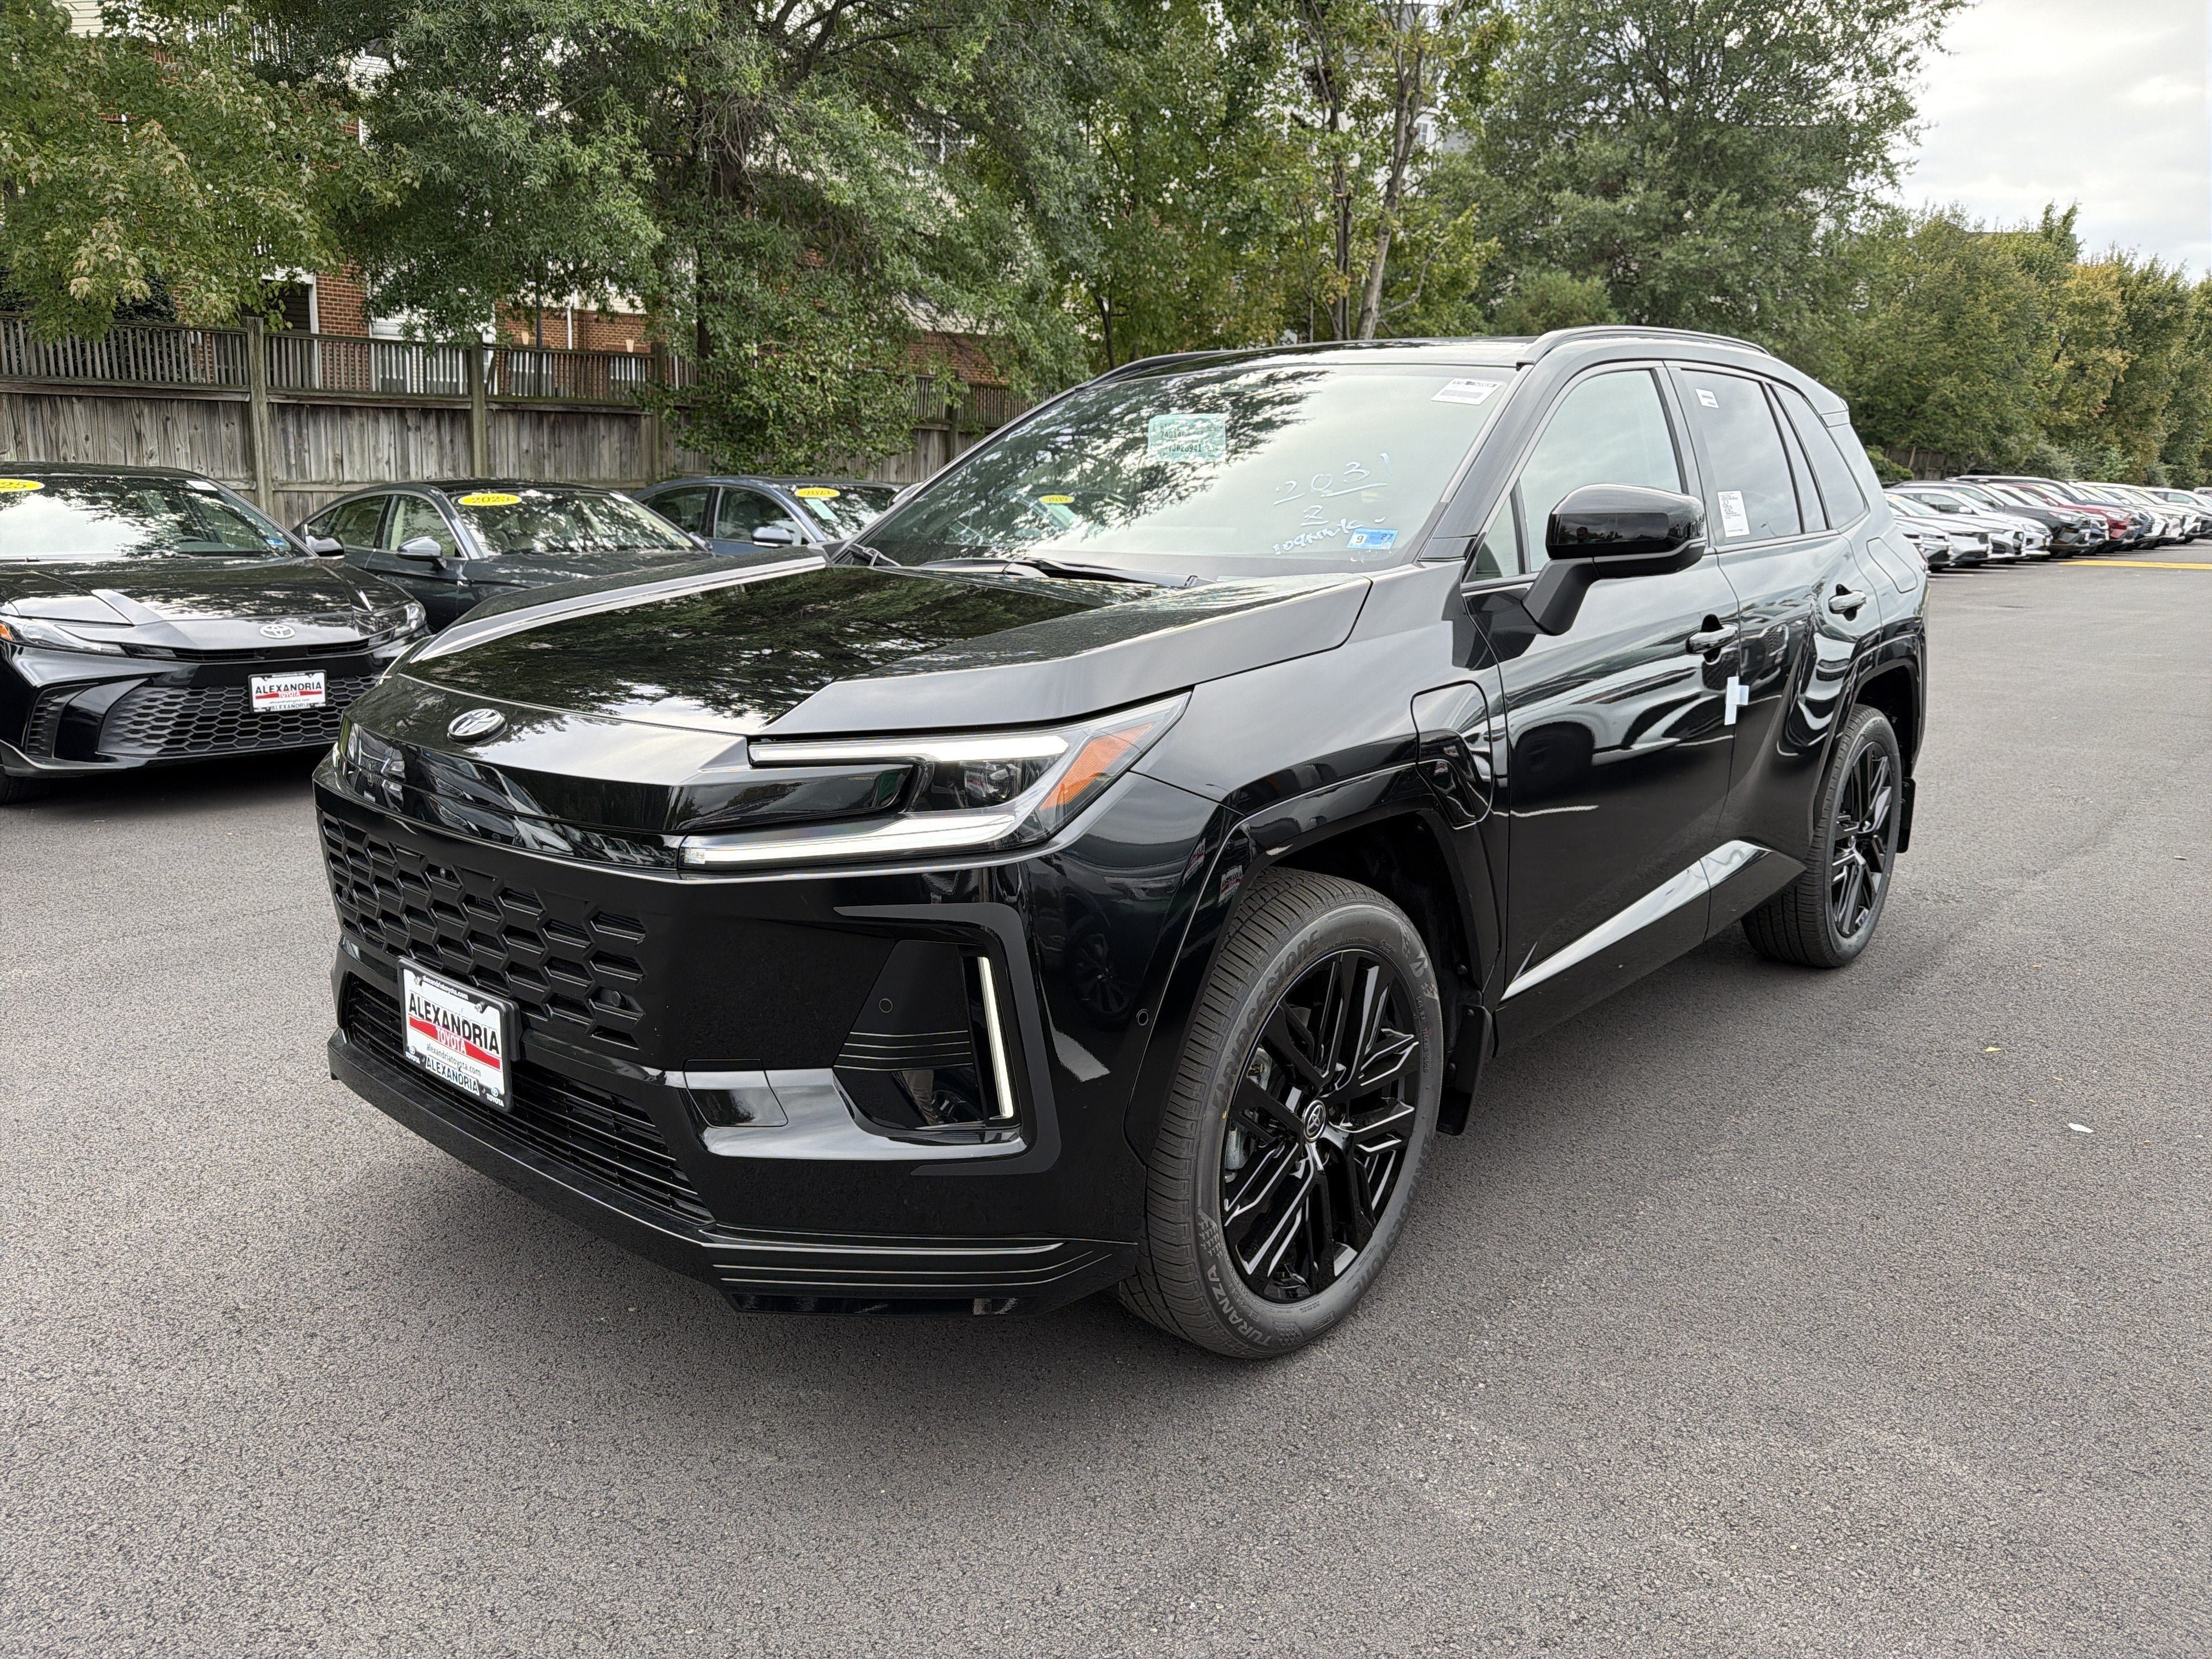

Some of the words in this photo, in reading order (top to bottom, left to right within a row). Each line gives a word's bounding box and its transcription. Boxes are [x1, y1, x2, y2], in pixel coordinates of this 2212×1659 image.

[1356, 535, 1364, 544] 9
[255, 681, 322, 695] ALEXANDRIA
[278, 690, 301, 698] TOYOTA
[409, 992, 500, 1055] ALEXANDRIA
[436, 1027, 467, 1054] TOYOTA
[405, 1051, 421, 1064] TOYOTA
[426, 1042, 481, 1077] alexandriatoyota.com
[426, 1057, 479, 1096] ALEXANDRIA
[486, 1093, 504, 1107] TOYOTA
[1206, 1264, 1272, 1346] TURANZA
